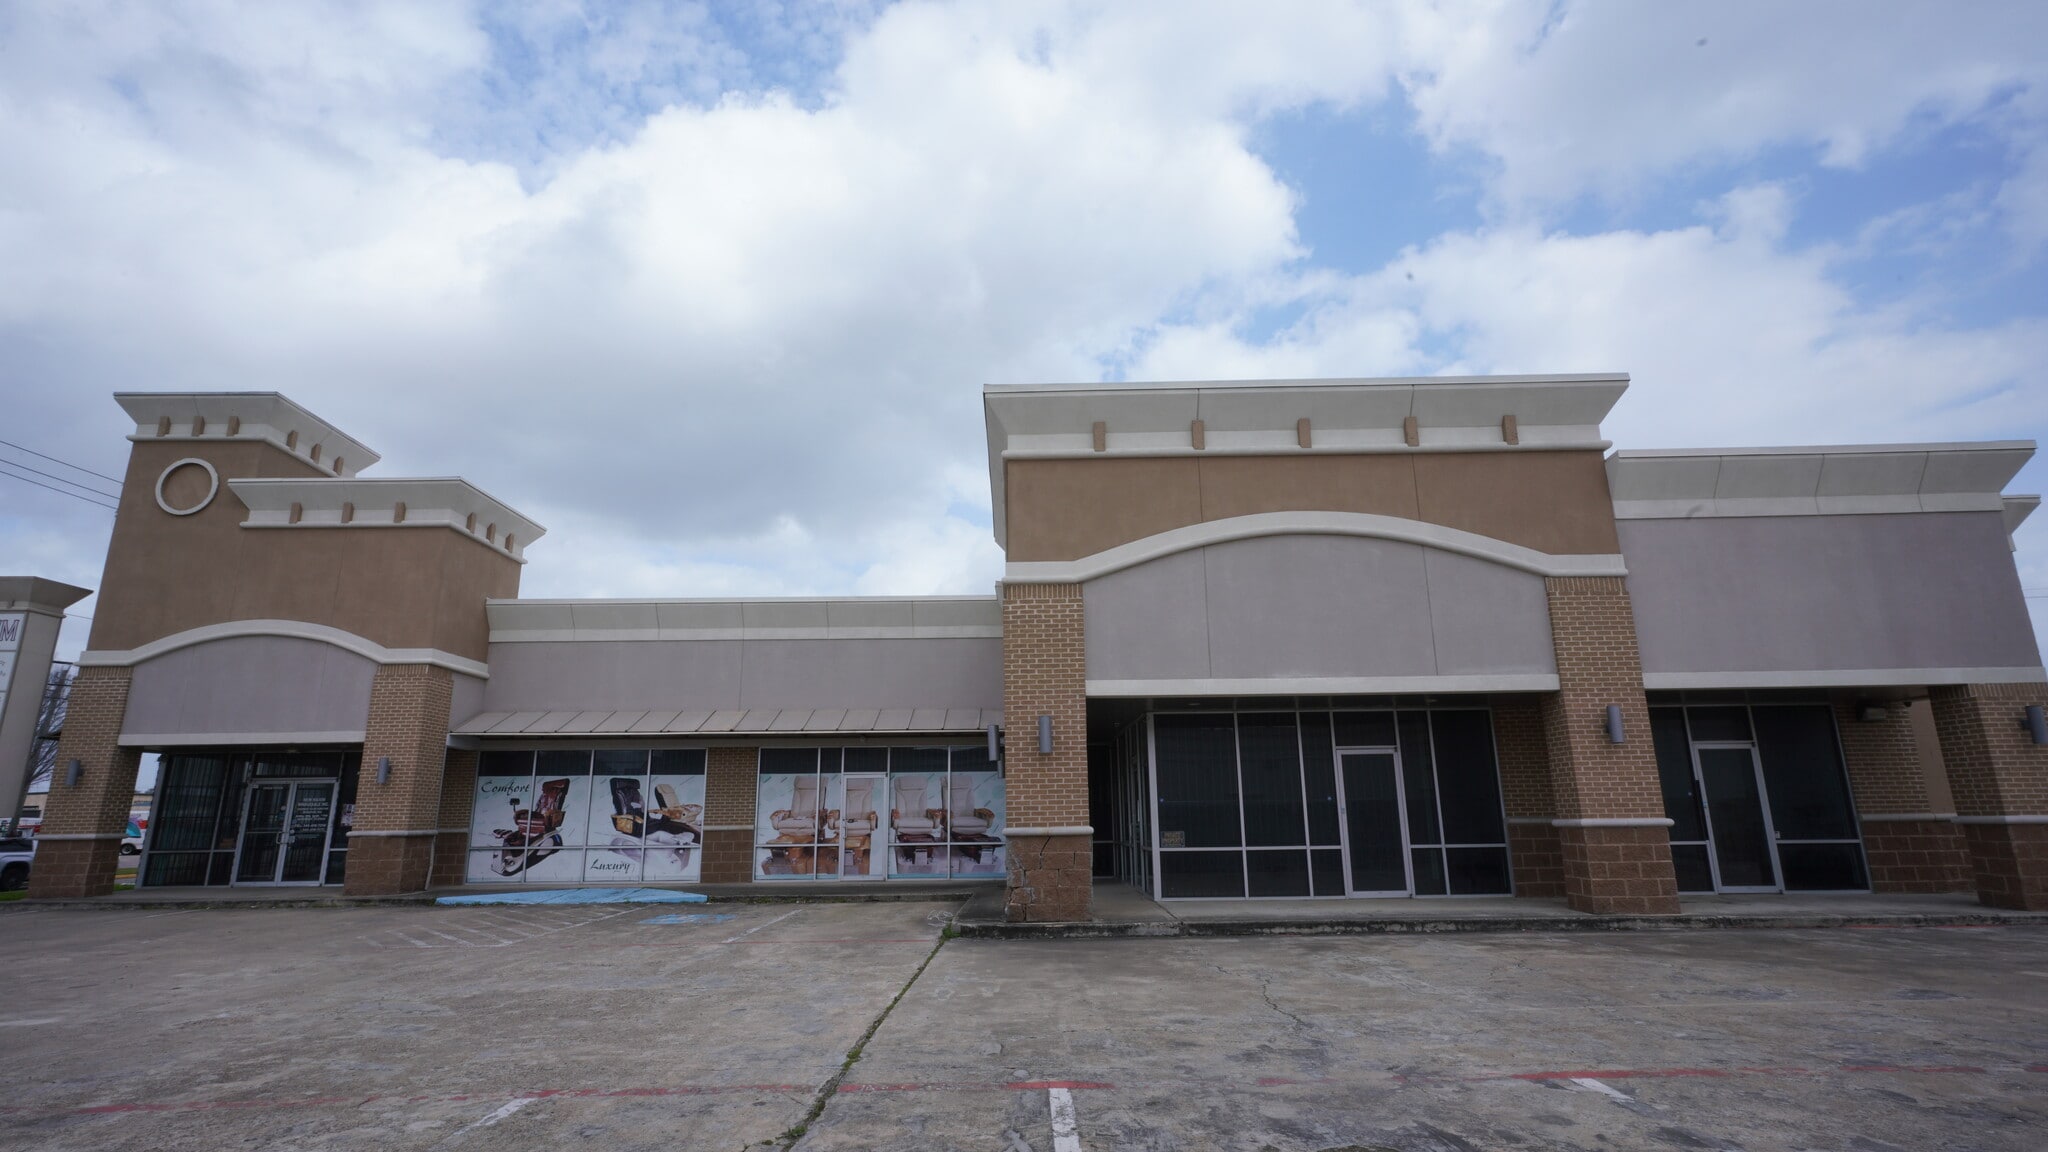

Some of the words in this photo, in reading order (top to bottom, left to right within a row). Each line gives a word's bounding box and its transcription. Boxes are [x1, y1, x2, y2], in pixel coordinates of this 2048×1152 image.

[0, 619, 20, 641] M
[481, 779, 530, 796] Comfort
[590, 858, 631, 874] Luxury
